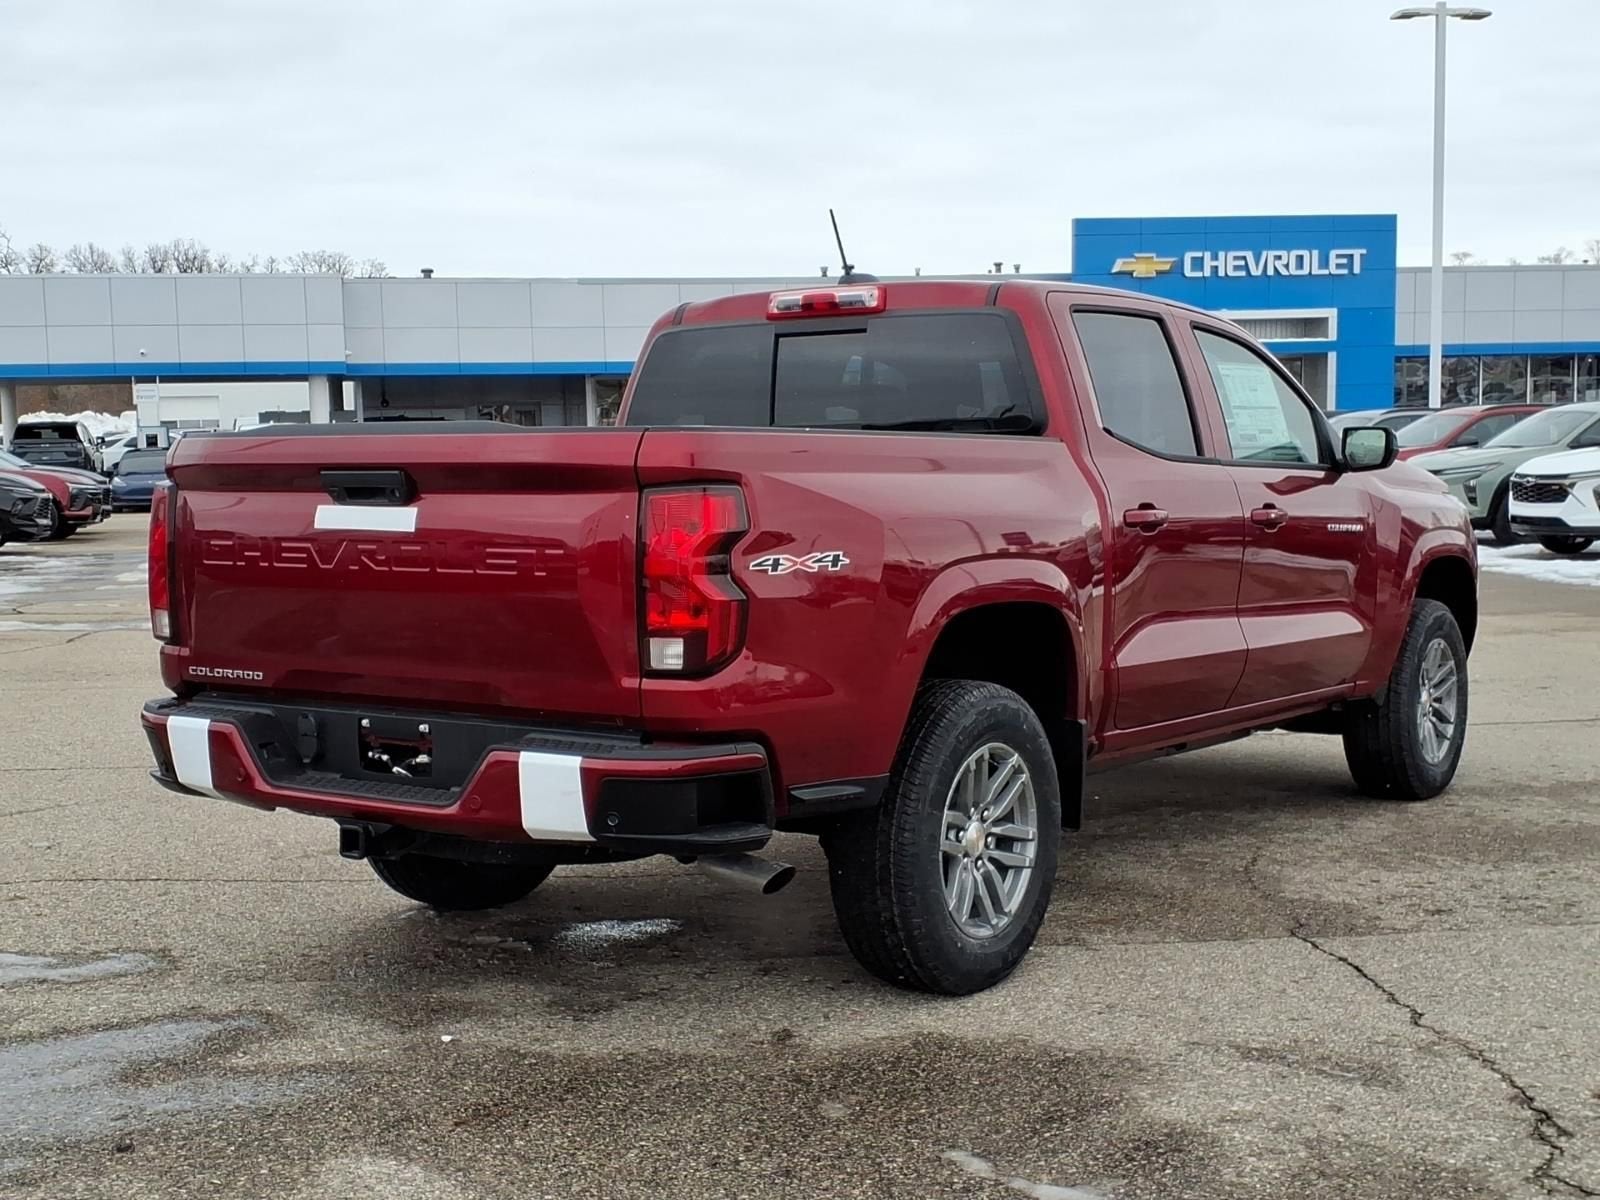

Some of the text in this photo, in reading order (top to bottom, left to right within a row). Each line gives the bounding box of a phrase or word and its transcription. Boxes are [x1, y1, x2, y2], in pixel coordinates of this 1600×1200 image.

[1183, 249, 1367, 278] CHEVROLET
[202, 537, 567, 576] CHEVROLET
[188, 665, 263, 680] COLORADO
